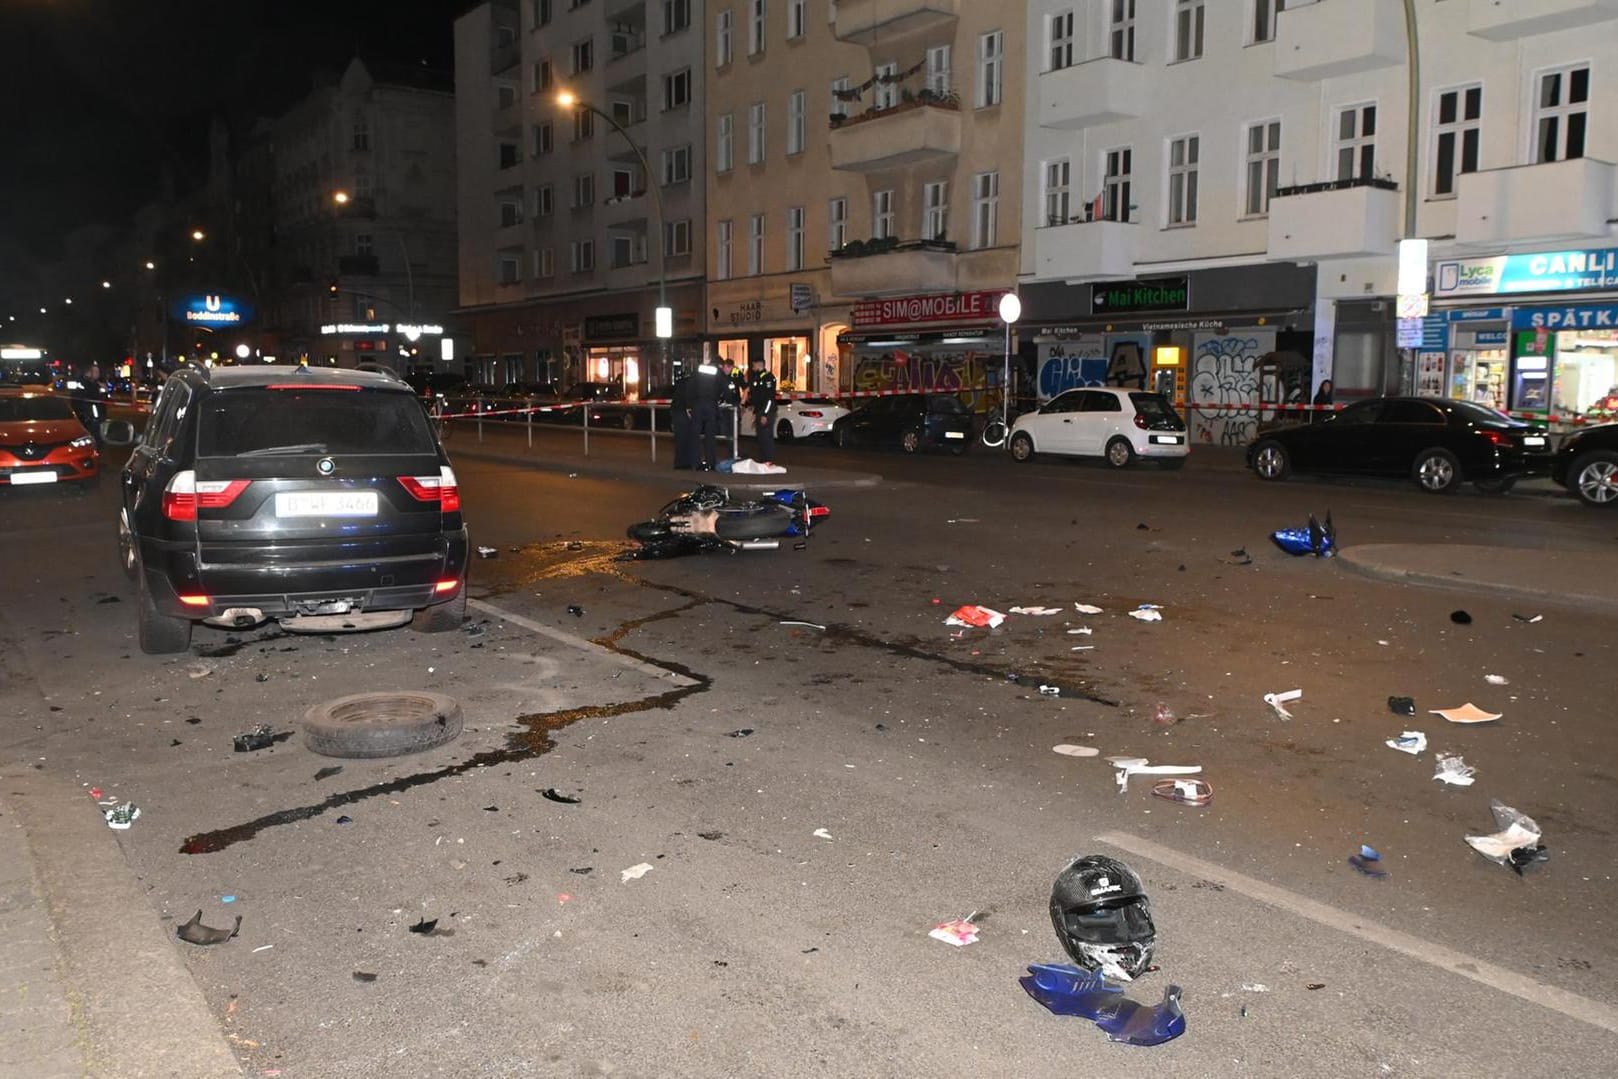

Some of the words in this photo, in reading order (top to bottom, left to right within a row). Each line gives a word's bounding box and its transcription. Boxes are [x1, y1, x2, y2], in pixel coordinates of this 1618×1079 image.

[1528, 252, 1614, 275] CANLI
[1460, 265, 1494, 279] Lyca
[206, 295, 221, 311] U
[1108, 290, 1132, 306] Mai
[1134, 288, 1186, 305] Kitchen
[883, 294, 981, 321] SIM@MOBILE
[186, 311, 240, 321] Boddinstraße
[1054, 327, 1078, 335] Kitchen
[1142, 322, 1197, 330] Vietnamesische
[1199, 320, 1223, 328] Küche
